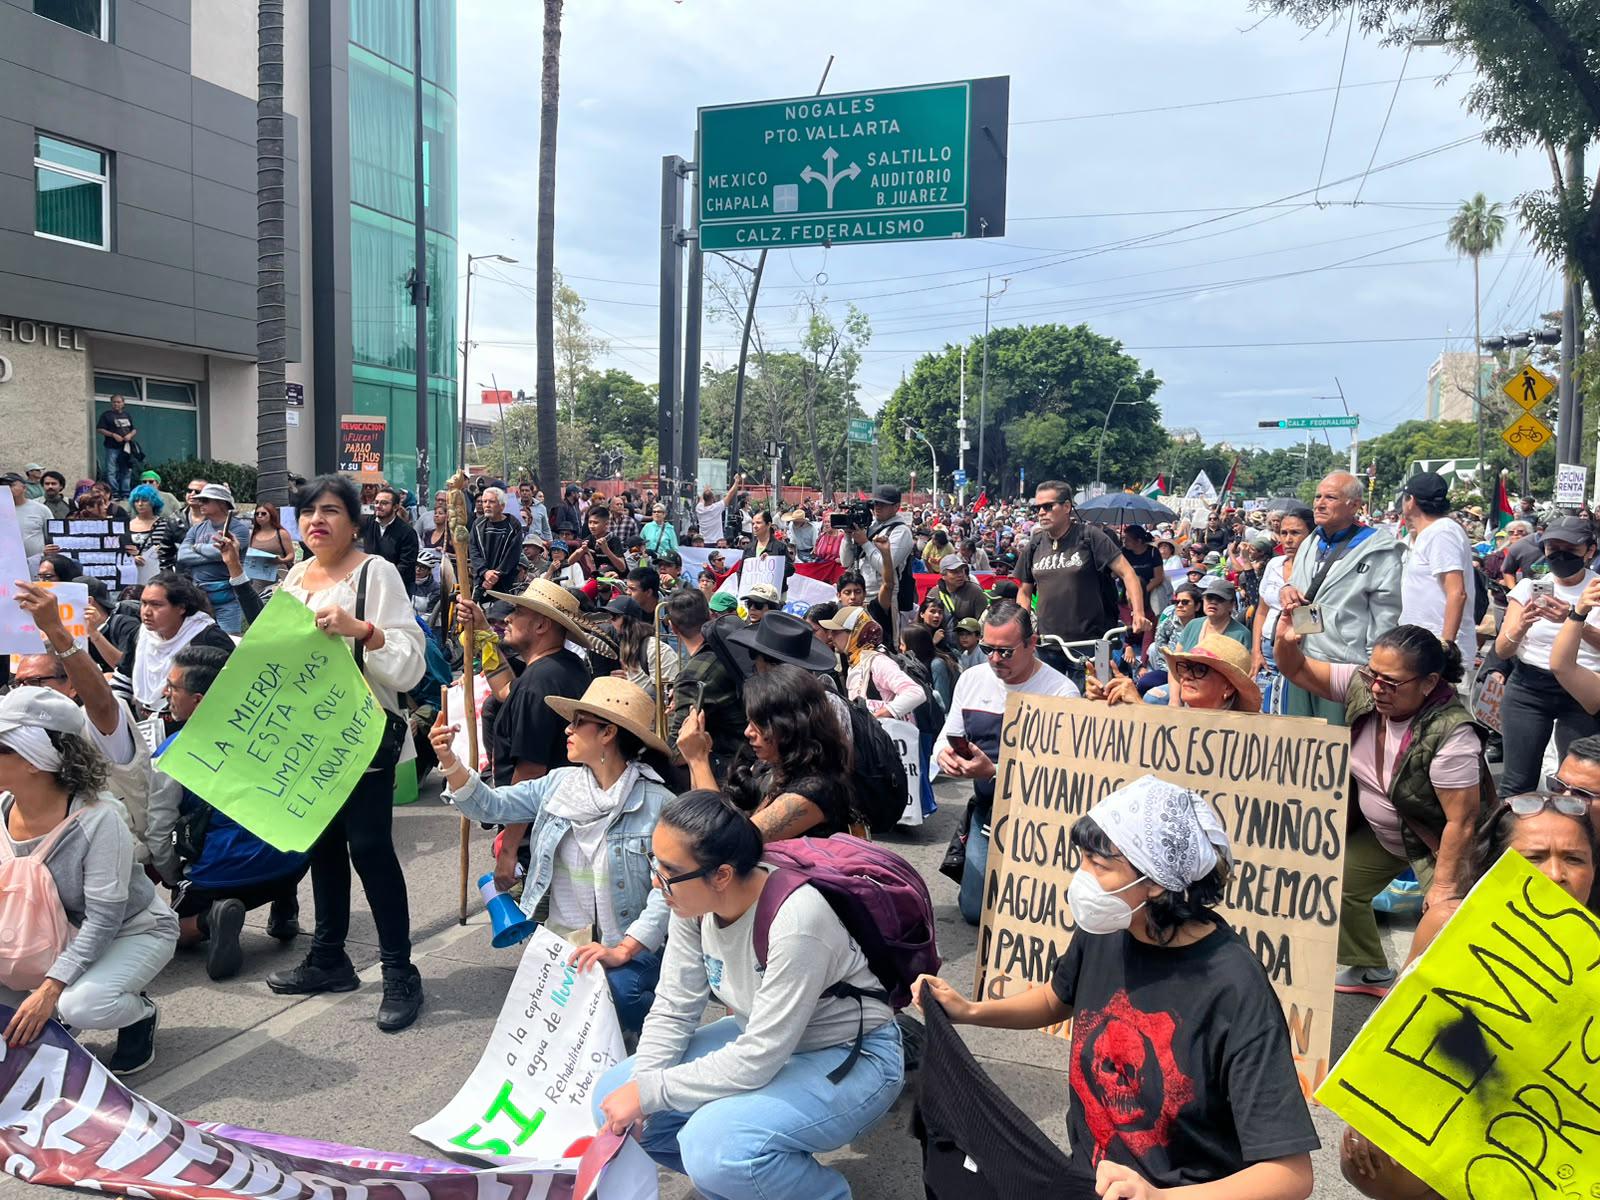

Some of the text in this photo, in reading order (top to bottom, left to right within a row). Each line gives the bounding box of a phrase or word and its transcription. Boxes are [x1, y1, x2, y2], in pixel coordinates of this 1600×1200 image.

[785, 97, 876, 120] NOGALES
[764, 119, 900, 145] PTO. VALLARTA
[867, 146, 952, 167] SALTILLO
[708, 171, 768, 189] MEXICO
[870, 168, 951, 188] AUDITORIO
[706, 195, 769, 212] CHAPALA
[877, 187, 948, 206] B. JUAREZ
[736, 218, 925, 243] CALZ. FEDERALISMO
[0, 320, 86, 350] HOTEL
[1310, 418, 1356, 426] FEDERALISMO
[344, 443, 371, 453] PABLO
[351, 452, 381, 462] LEMUS
[348, 463, 358, 471] SU
[1559, 472, 1584, 482] OFICINA
[1558, 483, 1583, 491] RENTA
[187, 662, 288, 773] LA MIERDA
[247, 650, 329, 762] ESTA MAS
[256, 683, 347, 797] LIMPIA QUE
[1070, 713, 1135, 764] VIVAN
[1139, 723, 1181, 772] LOS
[1185, 726, 1349, 801] ESTUDIANTES!
[287, 793, 317, 819] EL
[1019, 761, 1085, 815] VIVAN
[1246, 797, 1341, 861] NIÑOS
[1011, 818, 1049, 866] LOS
[1224, 858, 1339, 927] EREMOS
[545, 942, 563, 961] de
[1338, 875, 1600, 1146] LEMUS
[508, 1026, 529, 1046] la
[526, 1039, 549, 1077] agua
[543, 1011, 562, 1034] de
[506, 1050, 518, 1067] a
[447, 1079, 547, 1158] SI
